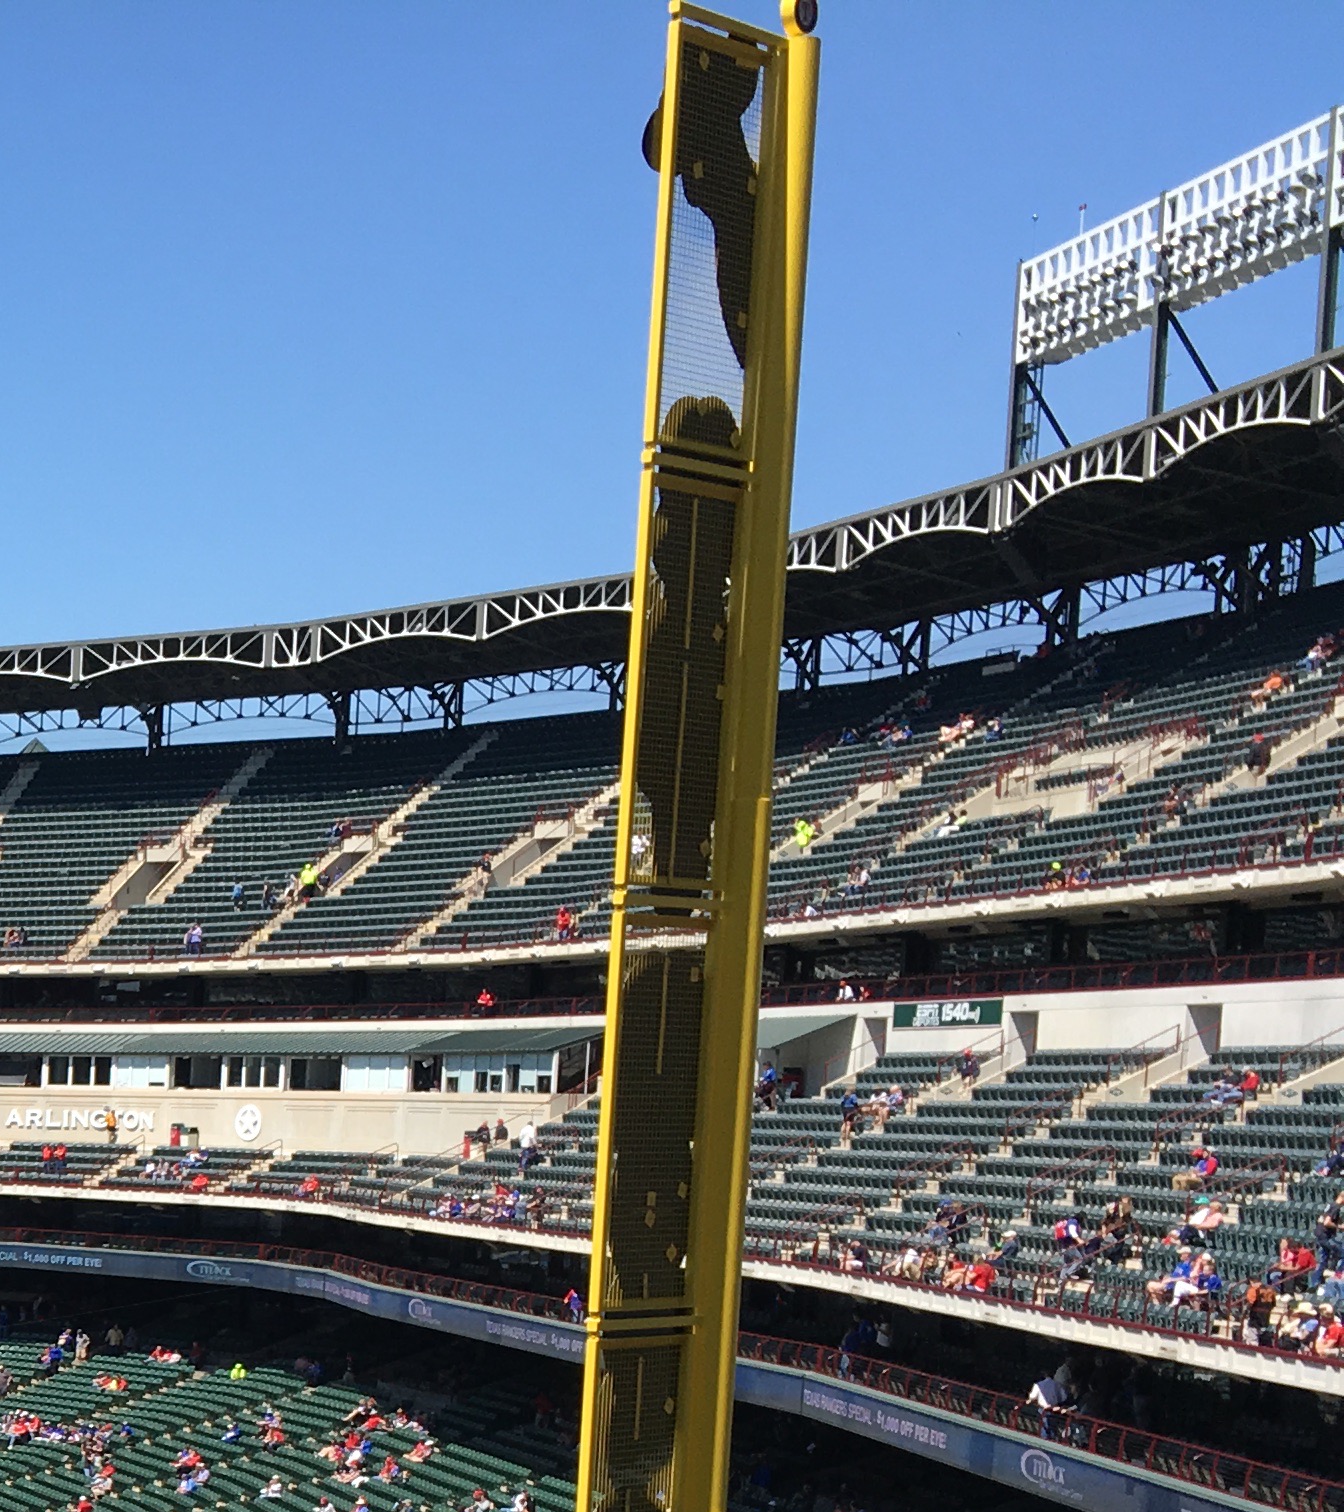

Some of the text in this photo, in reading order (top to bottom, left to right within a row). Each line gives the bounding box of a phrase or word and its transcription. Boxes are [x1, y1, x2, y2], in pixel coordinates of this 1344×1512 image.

[942, 1002, 970, 1022] 1540
[5, 1108, 155, 1130] ARLINGTON
[900, 1420, 914, 1438] OFF
[915, 1424, 929, 1444] PER
